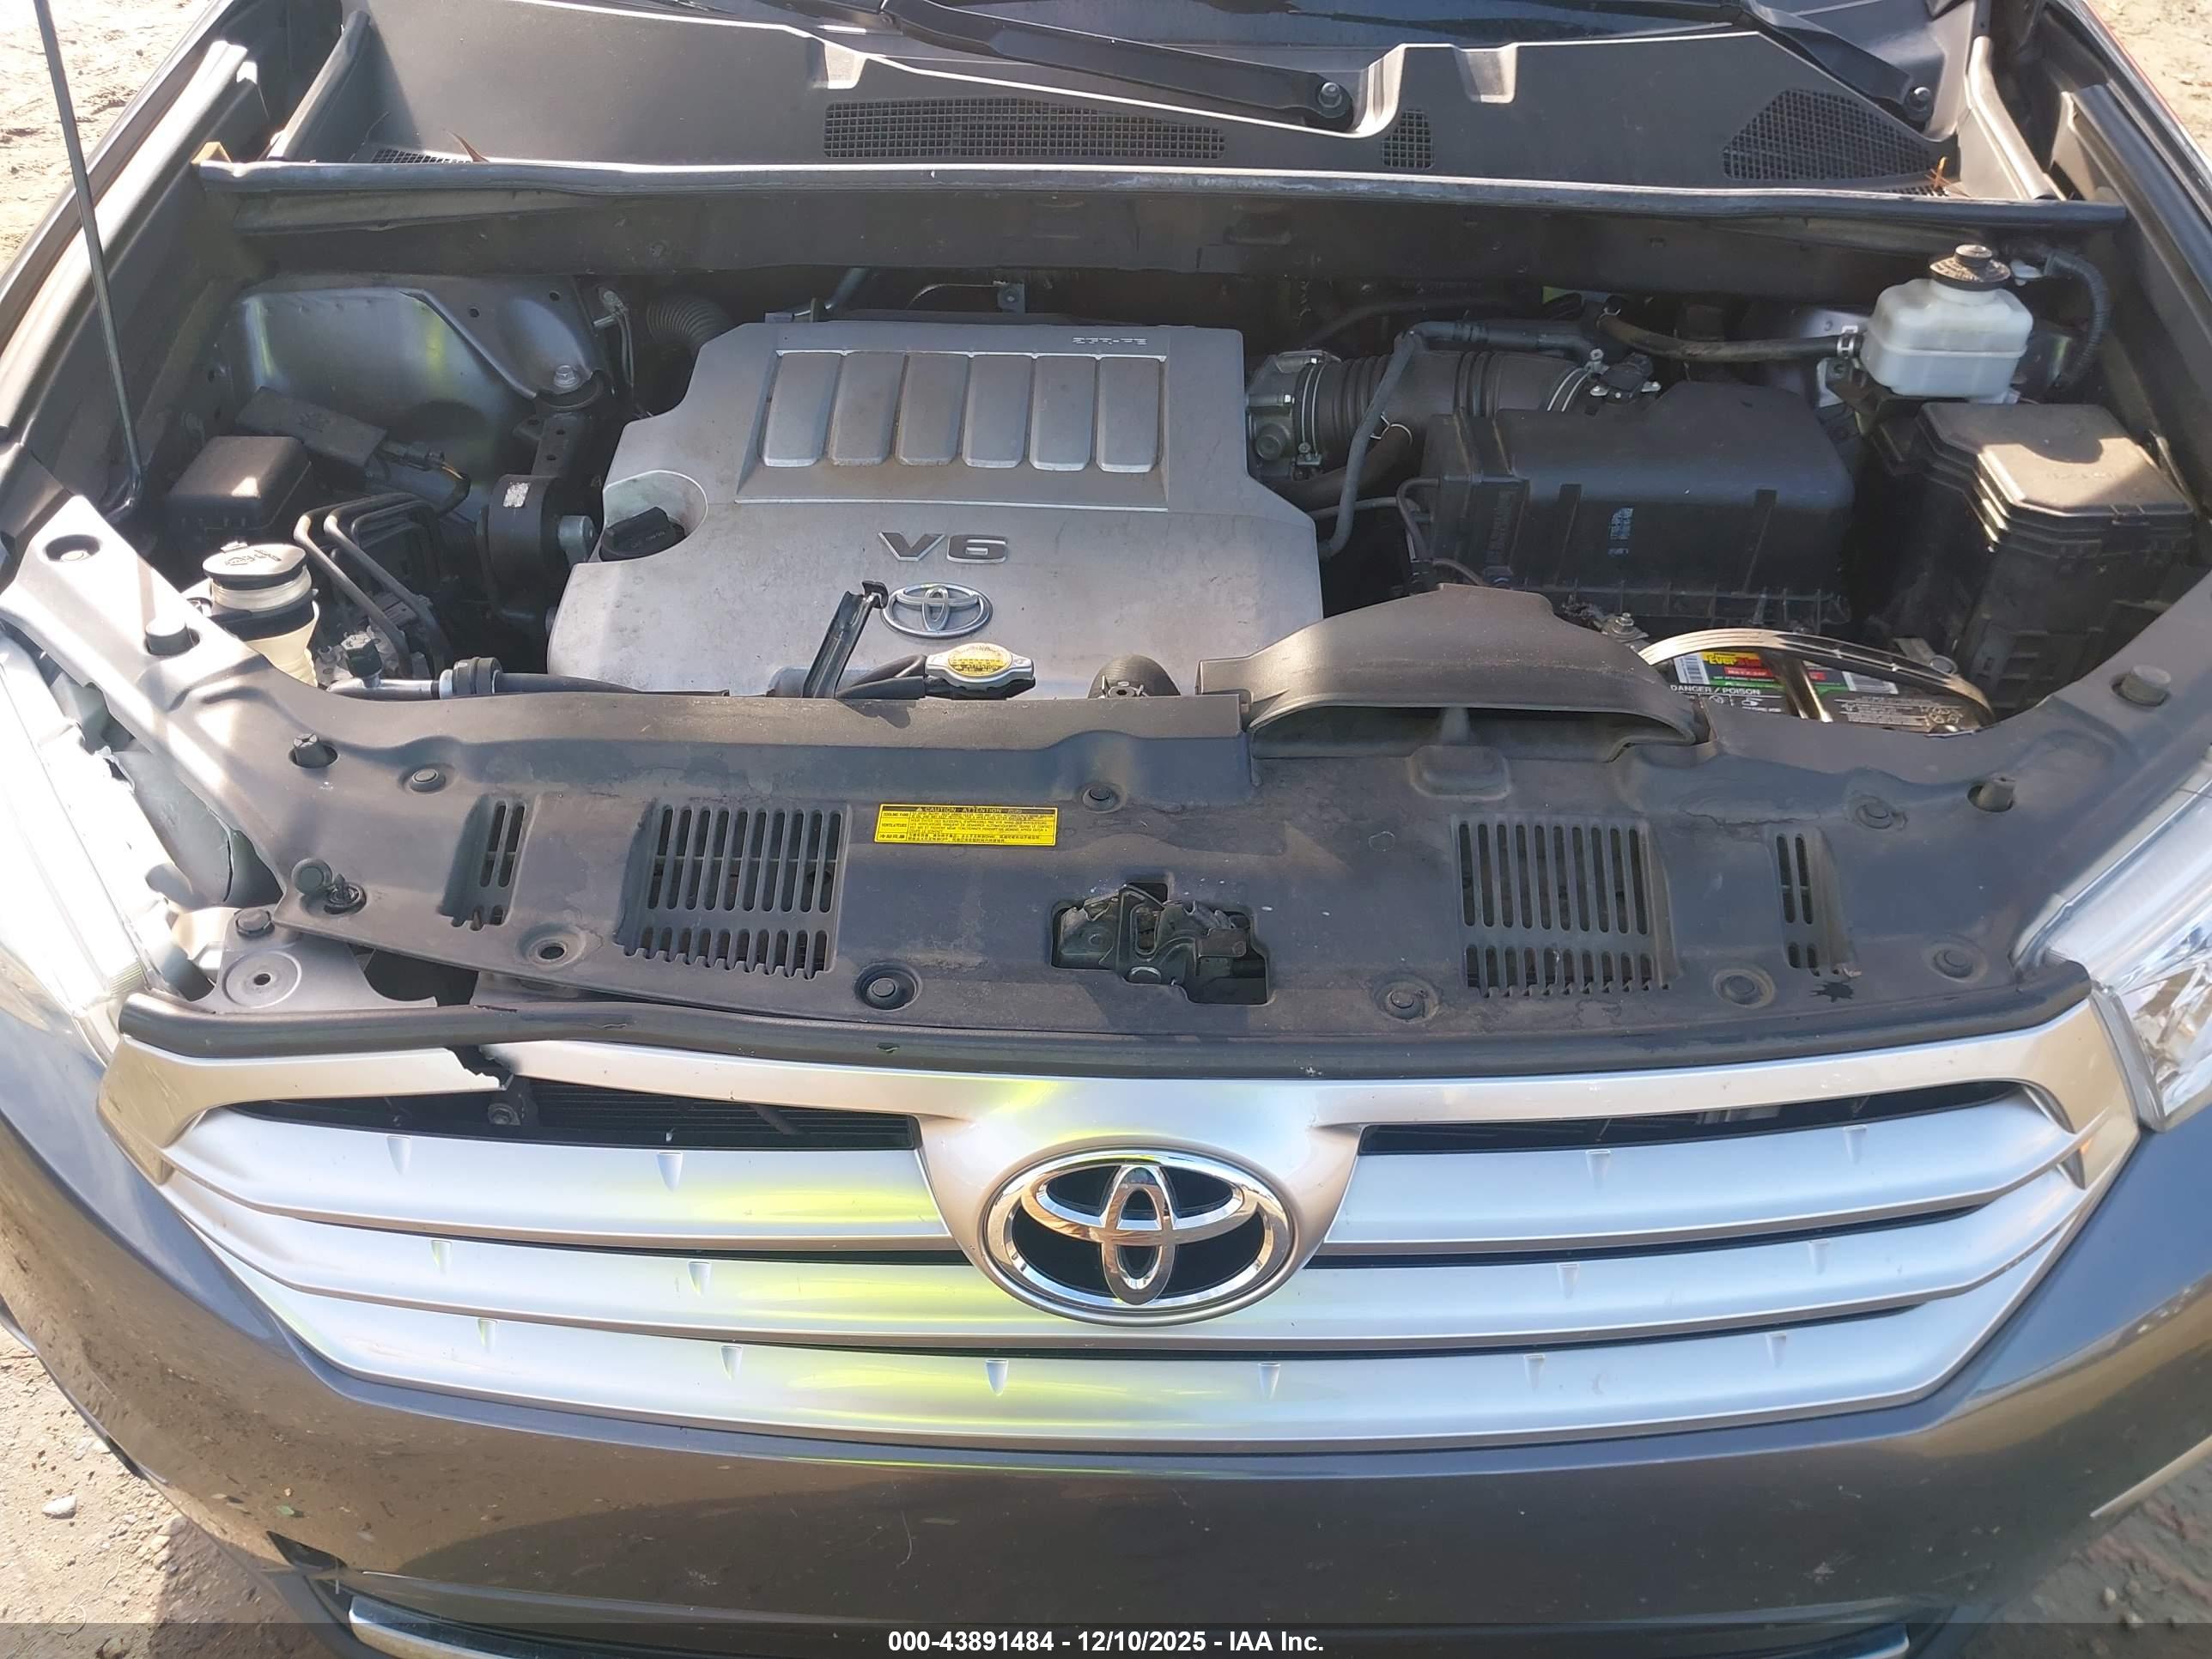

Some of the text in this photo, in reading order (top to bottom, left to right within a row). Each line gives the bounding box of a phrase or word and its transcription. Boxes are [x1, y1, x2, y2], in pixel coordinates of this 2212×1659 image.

[878, 531, 1008, 564] V6
[1669, 684, 1712, 693] DANGER
[1723, 687, 1761, 696] POISON
